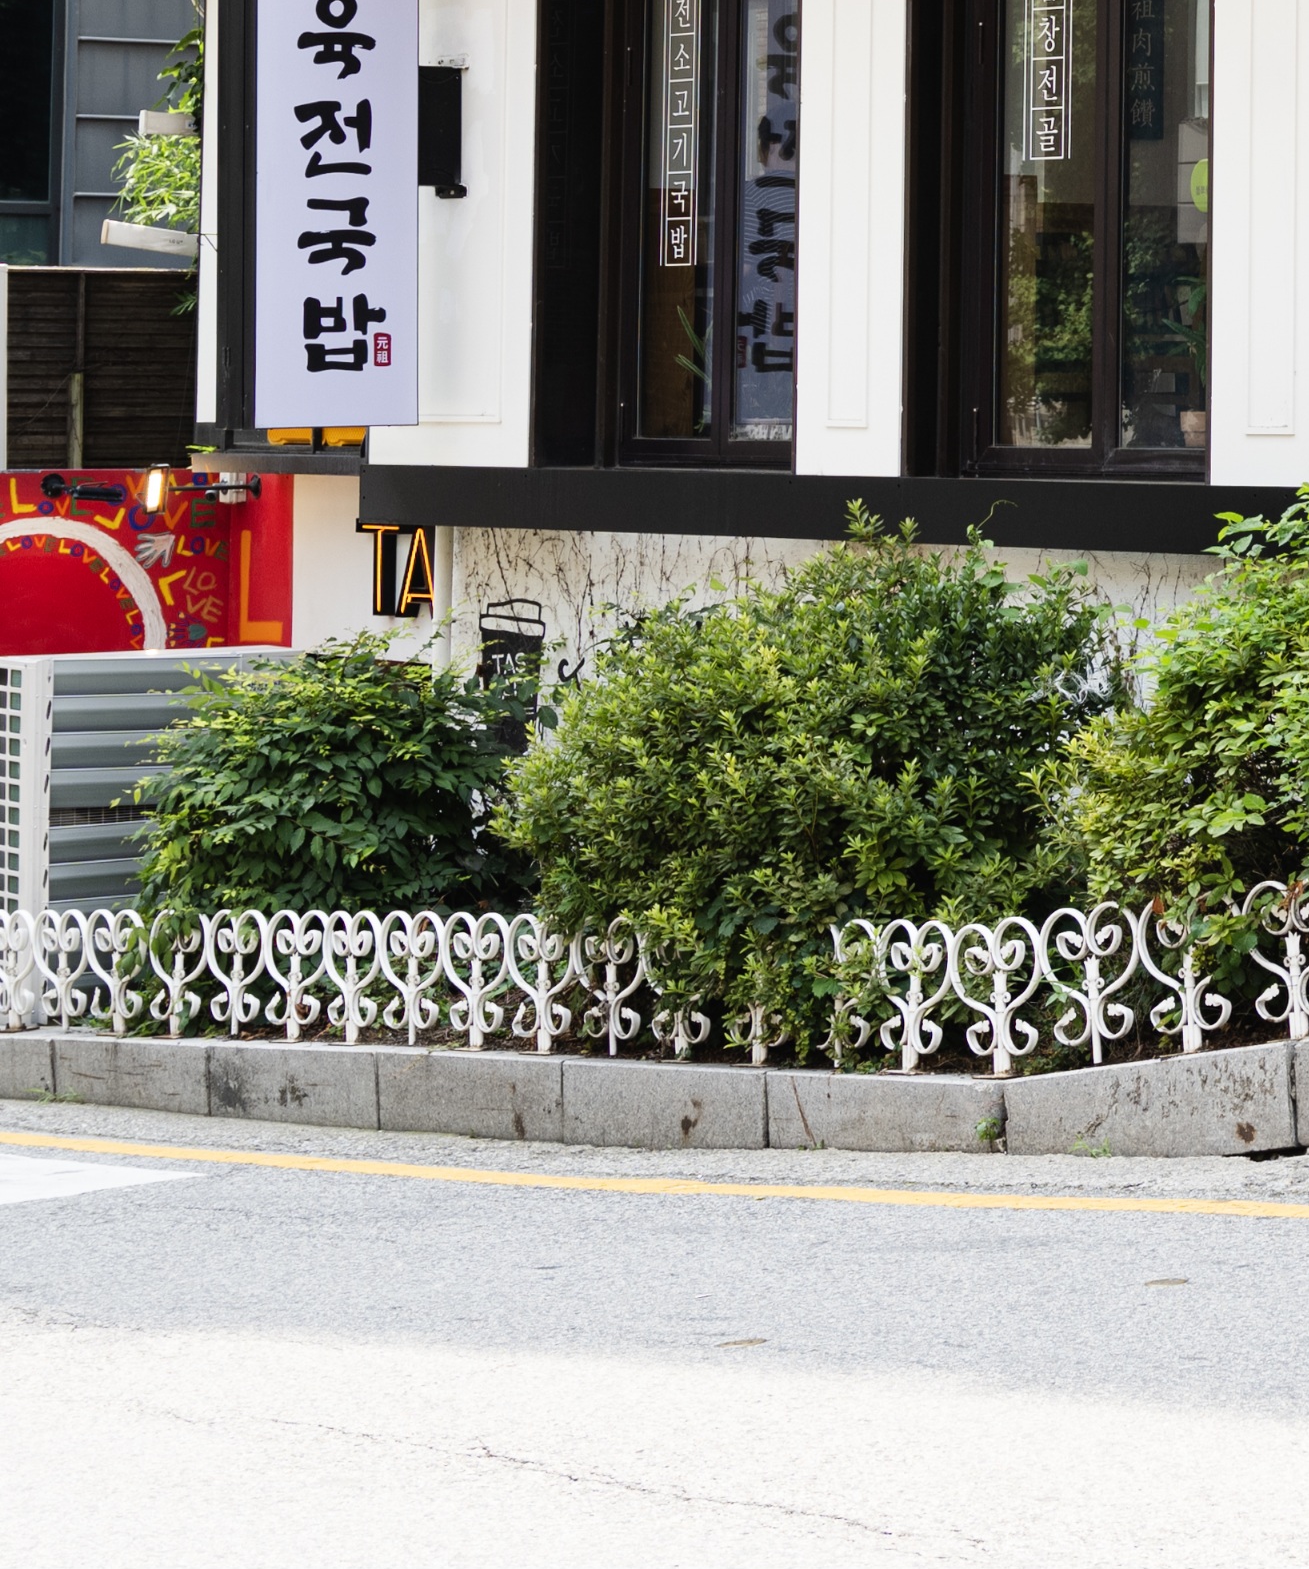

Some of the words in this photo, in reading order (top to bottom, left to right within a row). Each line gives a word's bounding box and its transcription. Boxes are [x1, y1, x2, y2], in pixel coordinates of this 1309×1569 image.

[6, 535, 56, 553] LOVE
[58, 539, 104, 574] LOVE
[177, 534, 229, 561] LOVE
